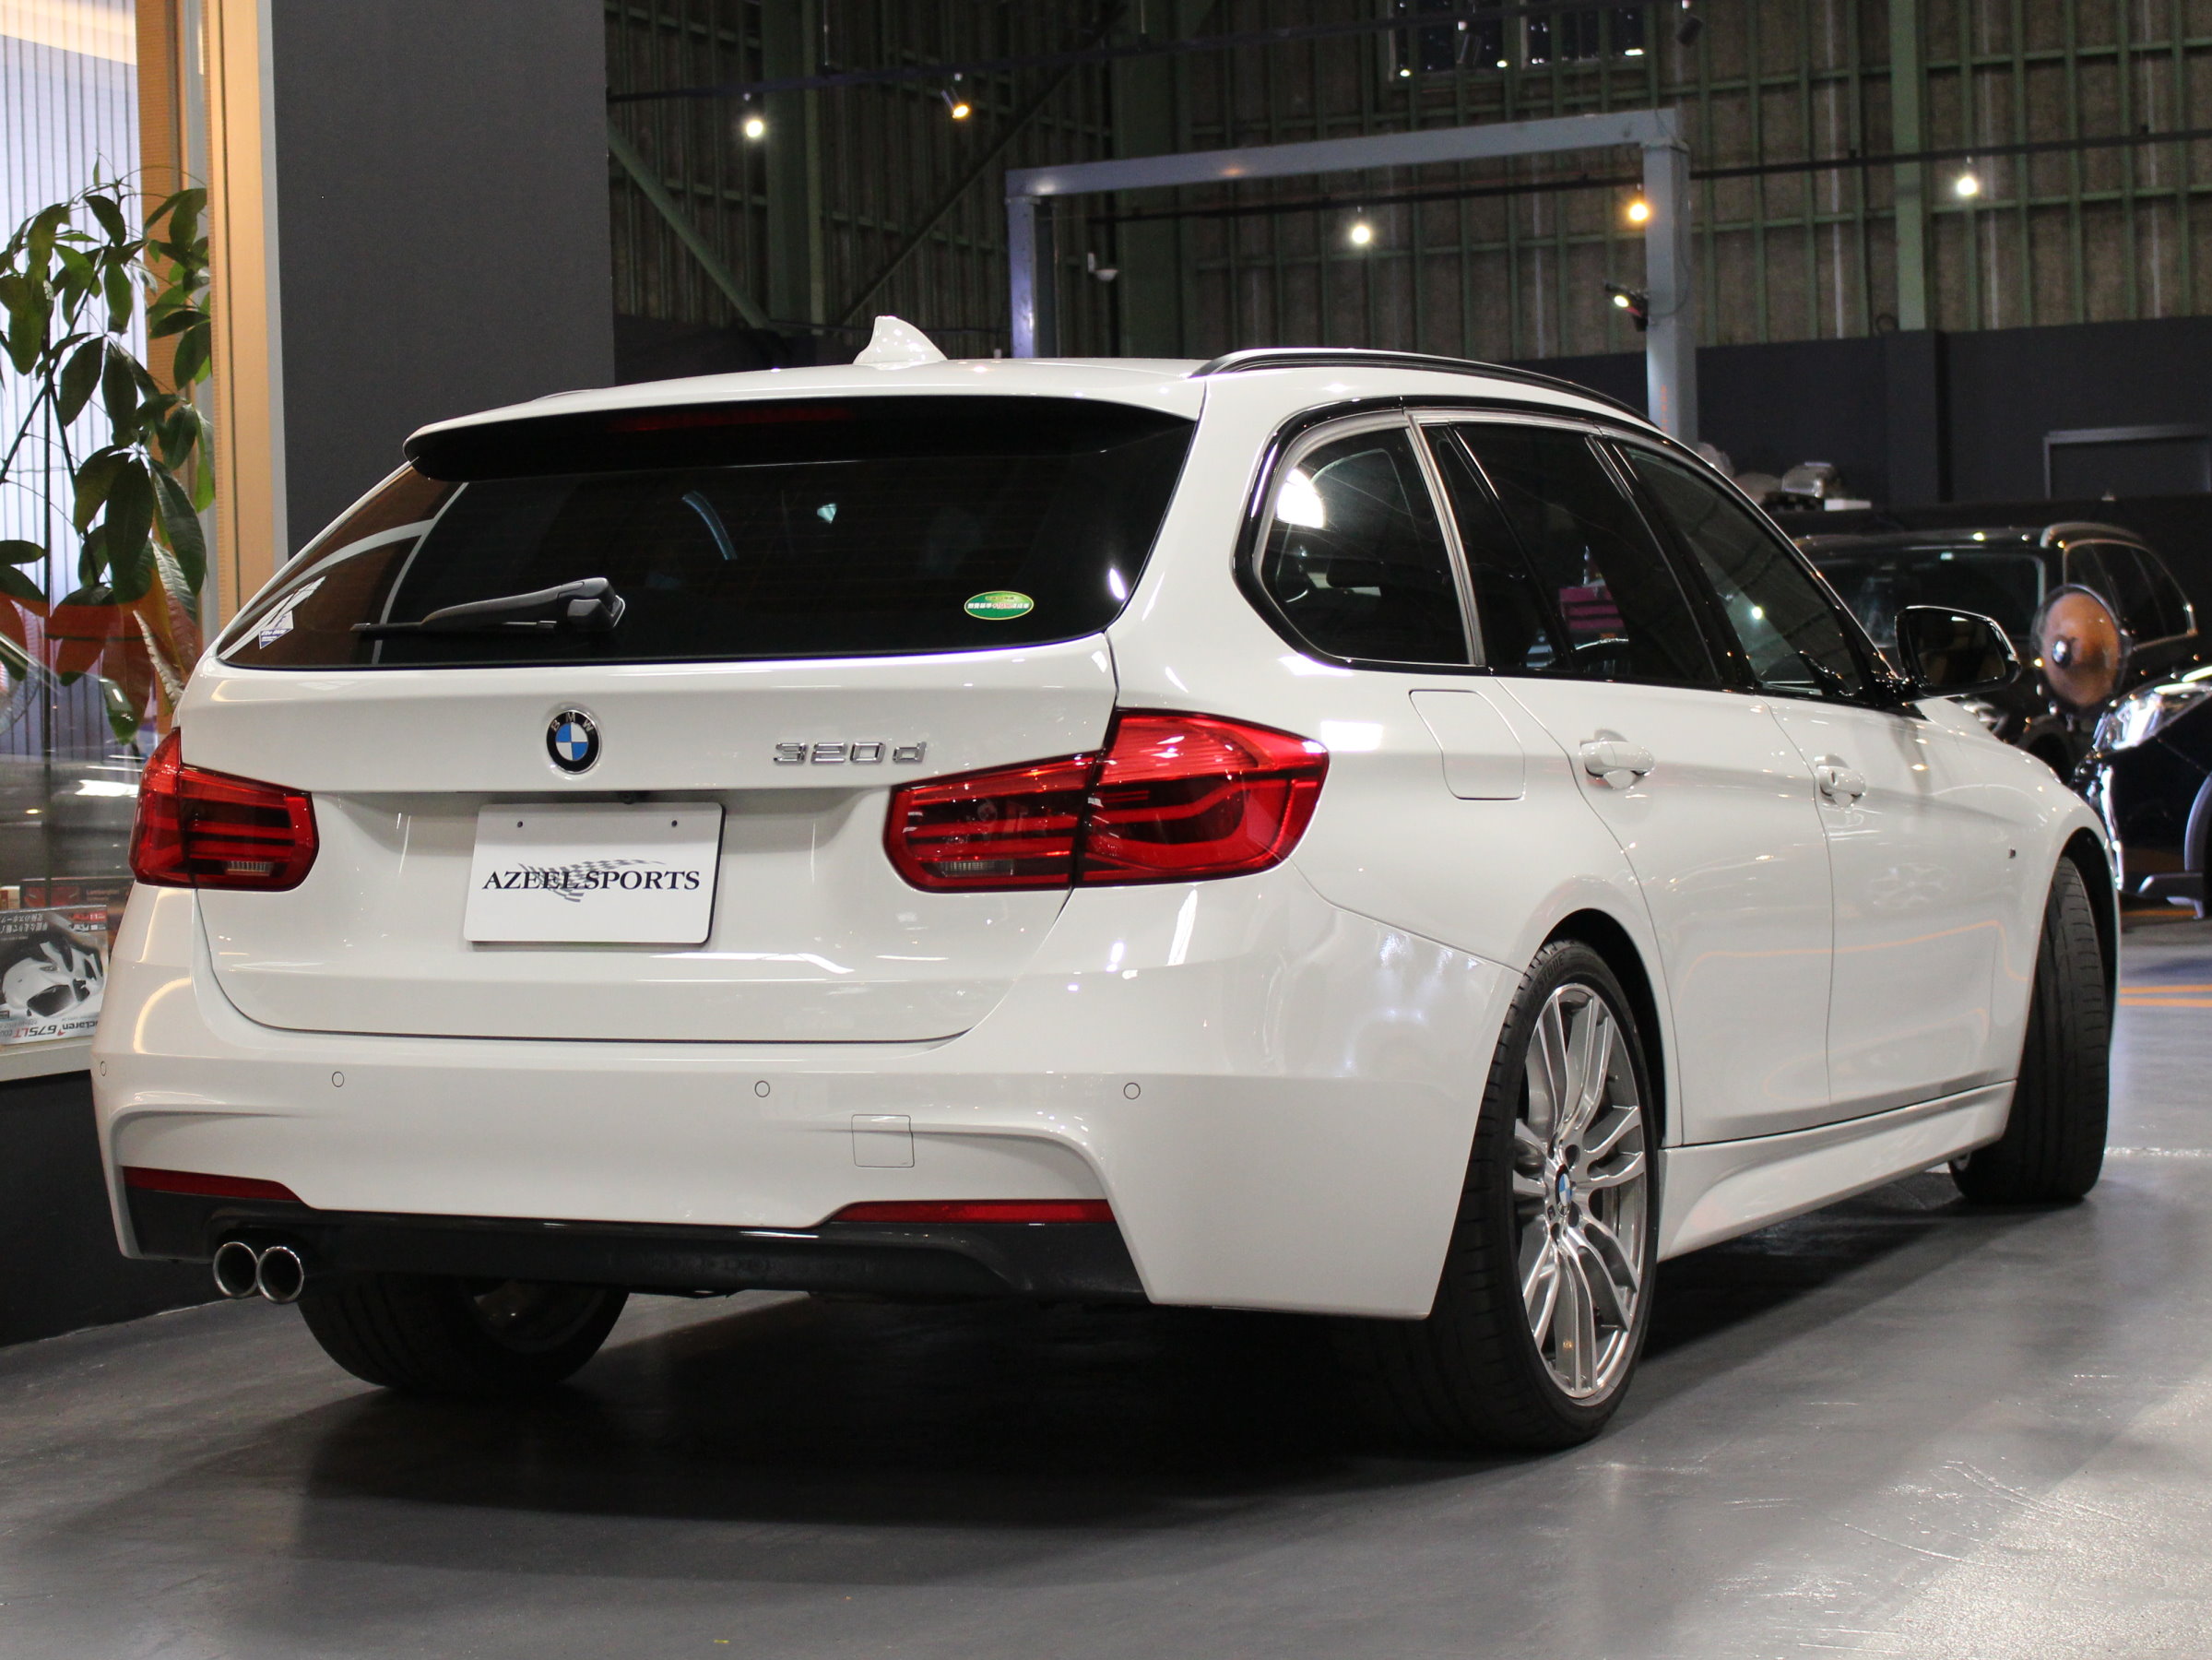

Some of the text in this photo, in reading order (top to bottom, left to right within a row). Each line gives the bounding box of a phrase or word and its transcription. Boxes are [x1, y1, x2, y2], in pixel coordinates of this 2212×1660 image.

[773, 741, 928, 765] 320d
[481, 871, 701, 890] AZEEL SPORTS
